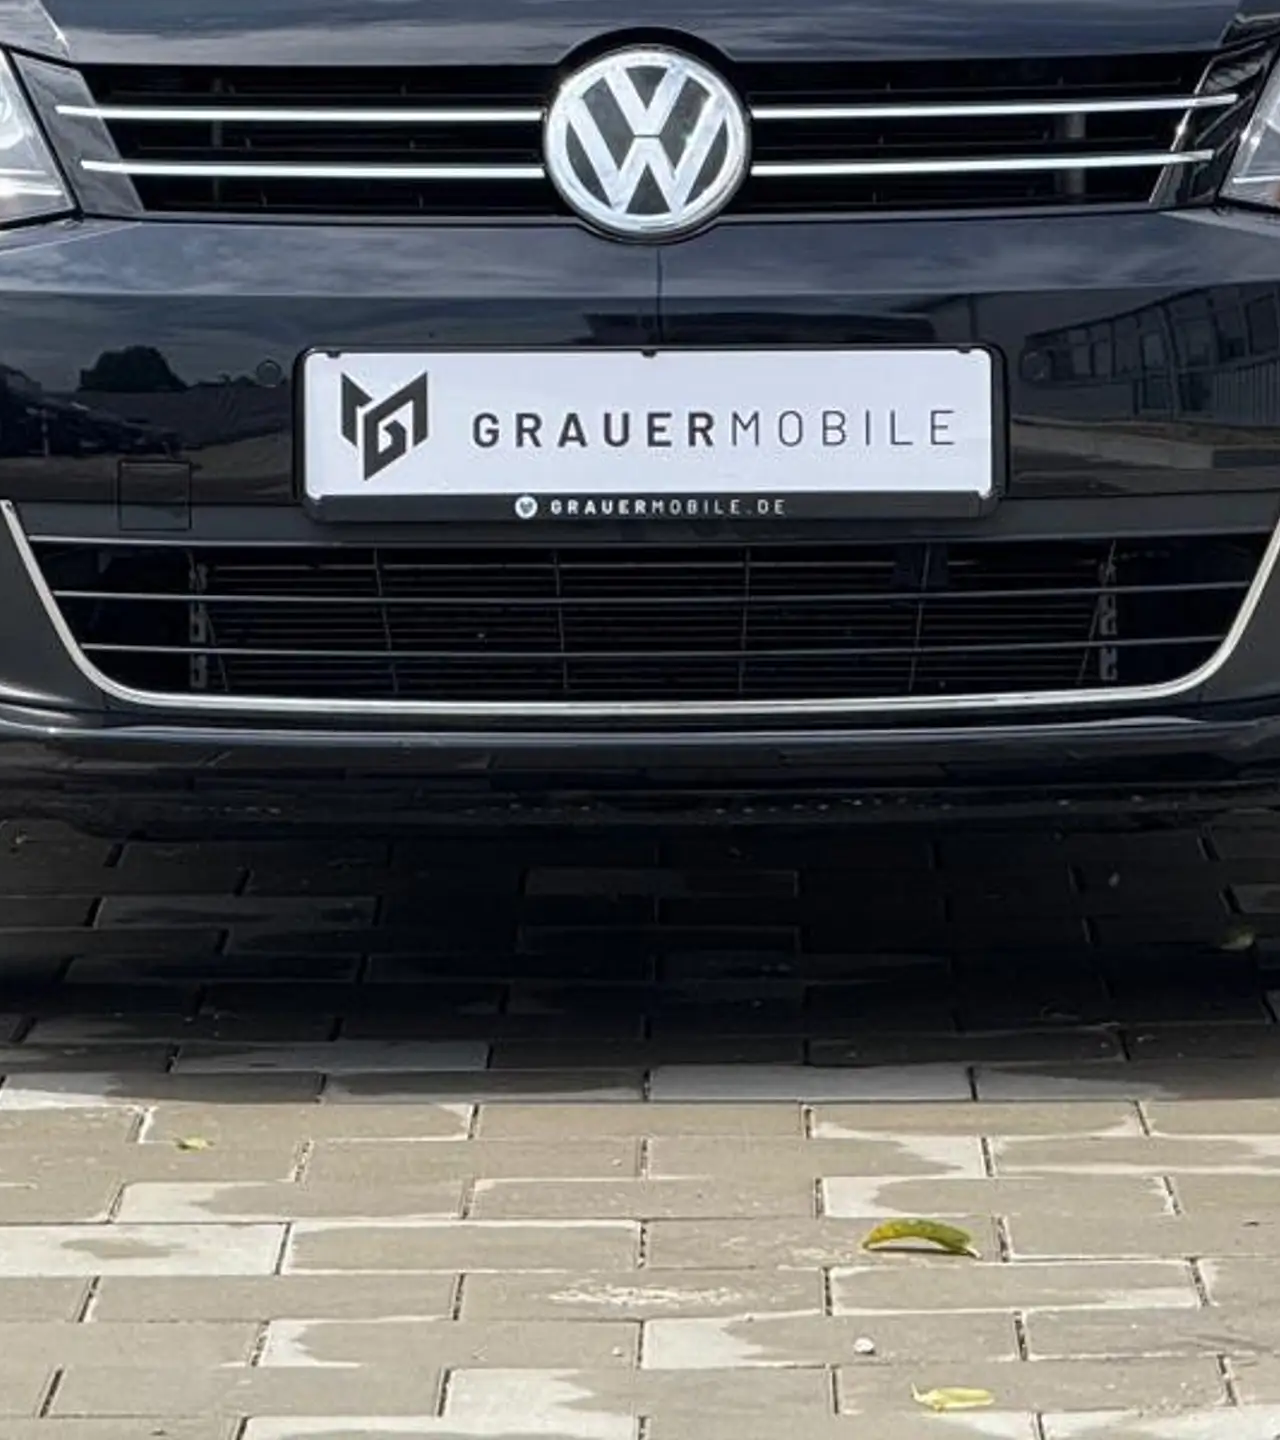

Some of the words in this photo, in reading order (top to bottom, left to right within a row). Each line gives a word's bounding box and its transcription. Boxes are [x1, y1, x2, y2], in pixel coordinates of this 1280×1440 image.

[563, 62, 731, 220] VW
[472, 409, 956, 449] GRAUERMOBILE
[550, 498, 786, 516] GRAUERMOBILE.DE
